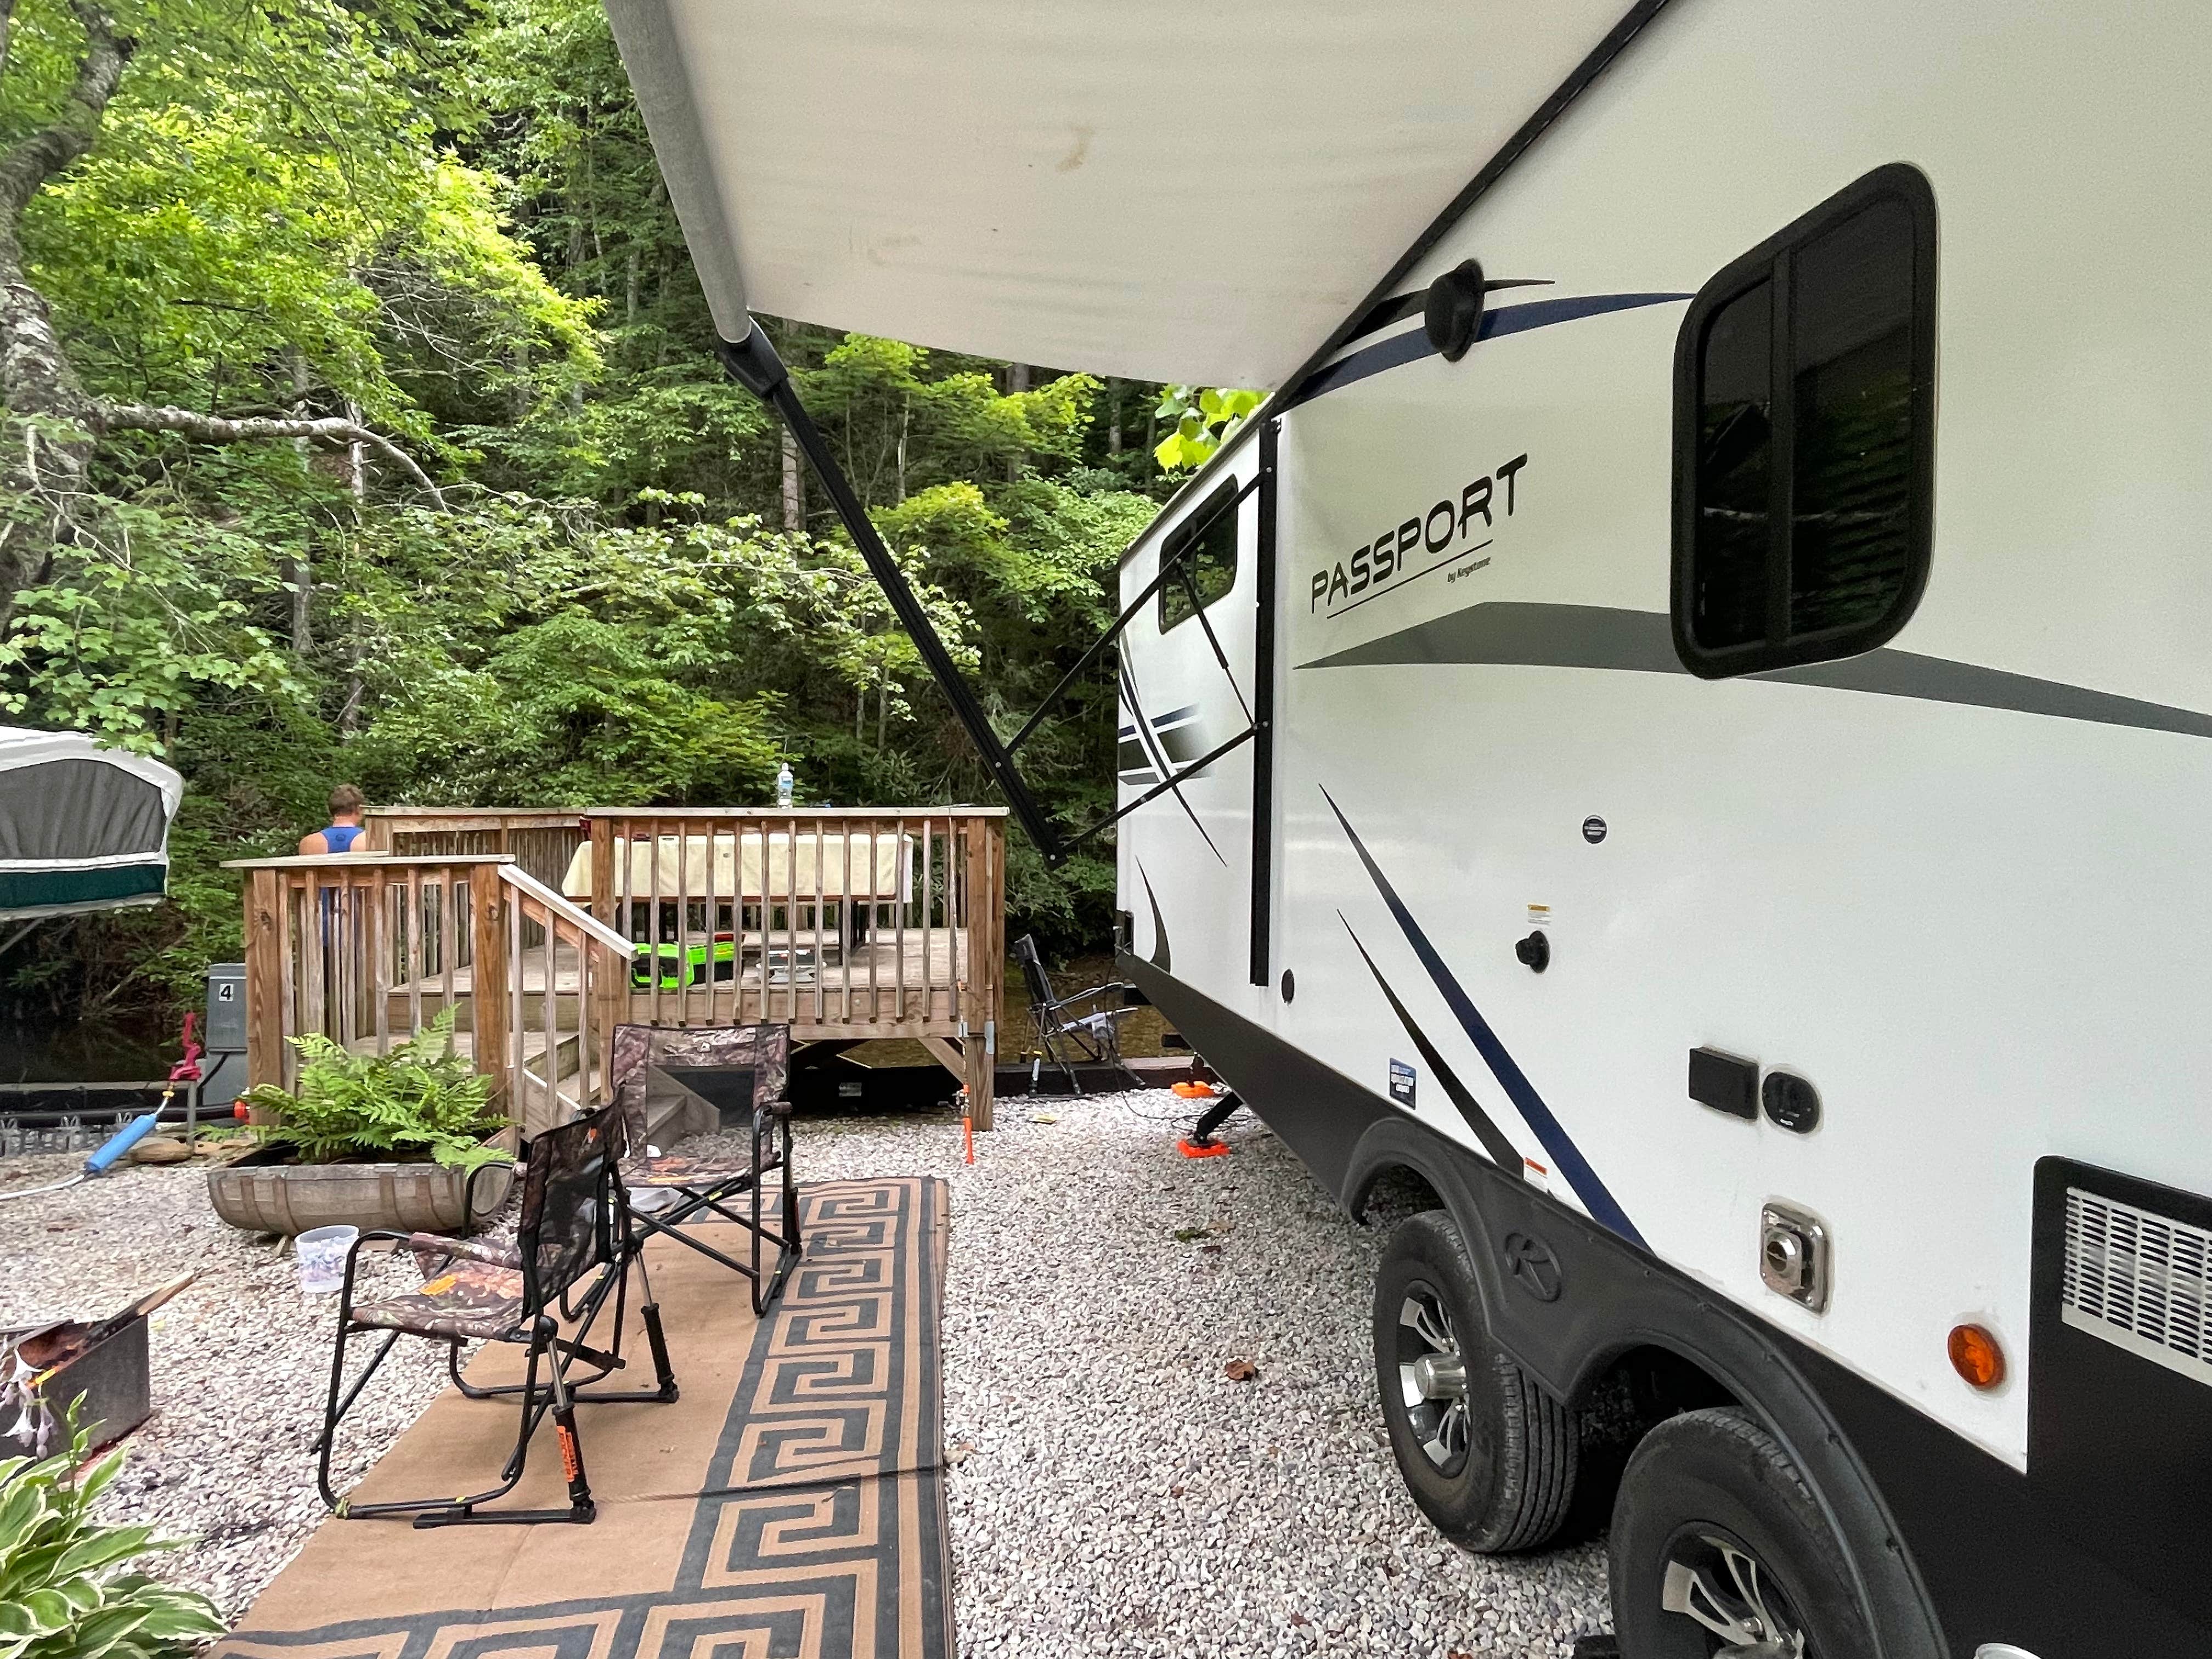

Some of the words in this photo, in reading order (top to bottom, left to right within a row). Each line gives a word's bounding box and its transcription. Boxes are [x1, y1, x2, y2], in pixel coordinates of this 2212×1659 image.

[1312, 453, 1528, 614] PASSPORT
[1447, 572, 1456, 584] by
[1457, 556, 1491, 578] Keystone
[221, 985, 230, 1000] 4
